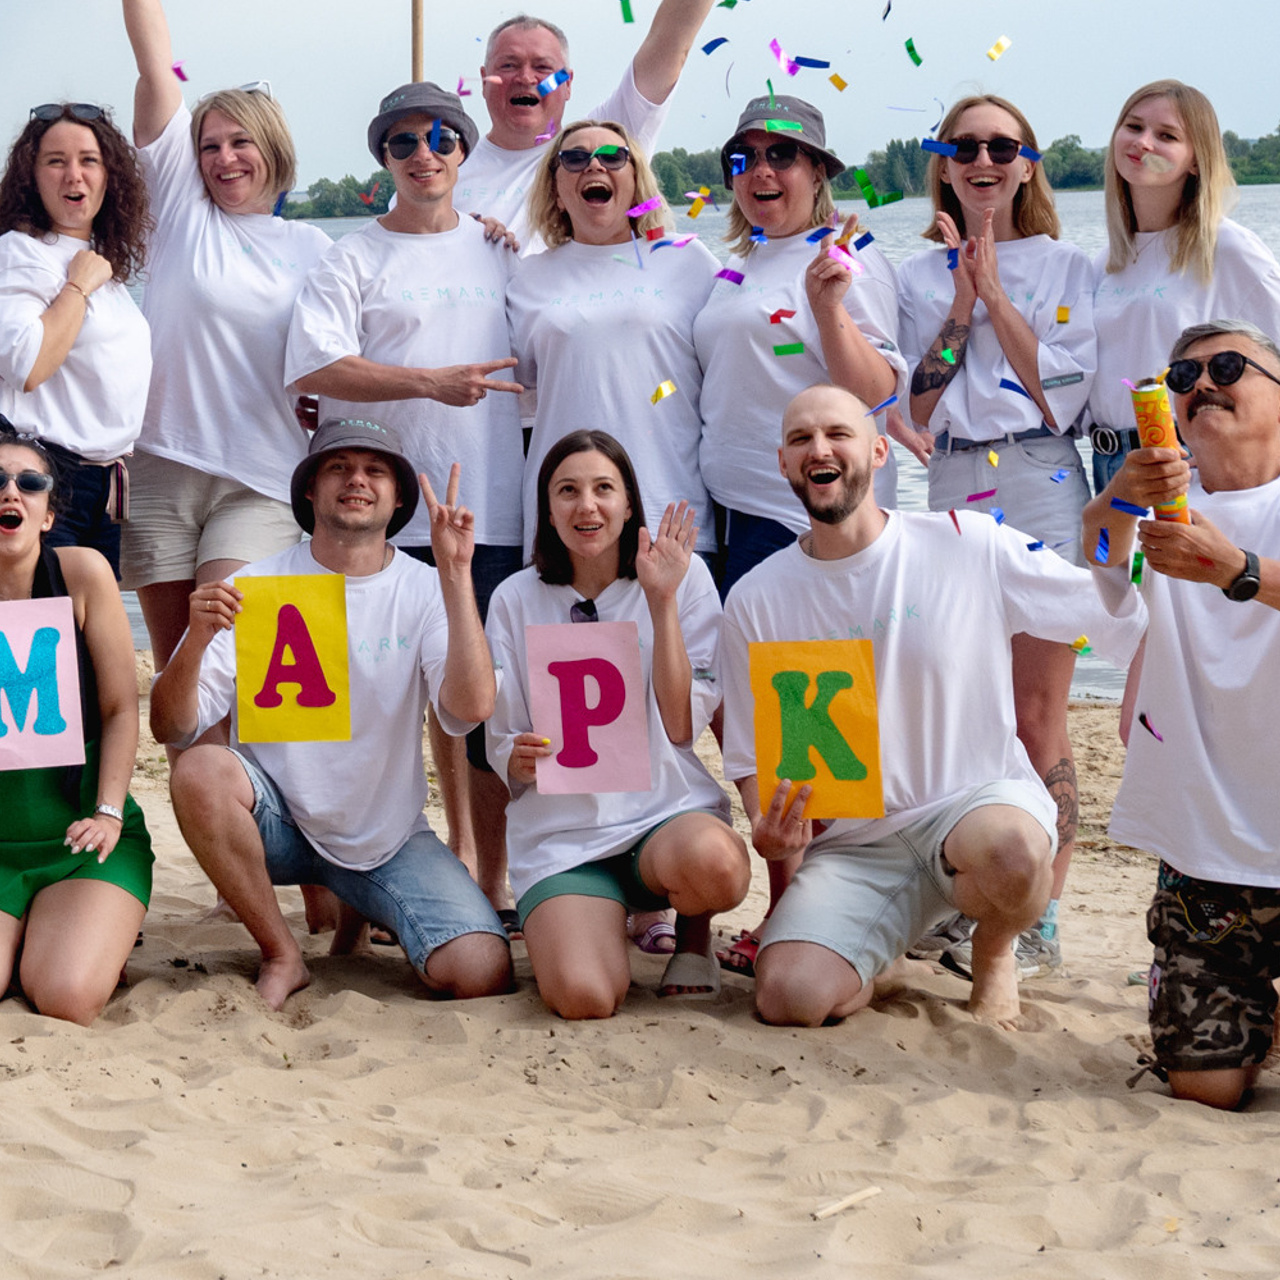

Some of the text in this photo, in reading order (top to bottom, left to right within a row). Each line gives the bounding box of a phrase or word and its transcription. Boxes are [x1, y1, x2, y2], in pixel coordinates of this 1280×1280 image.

[401, 286, 499, 301] REMARK
[551, 286, 664, 305] REMARK
[808, 604, 920, 640] EMARK
